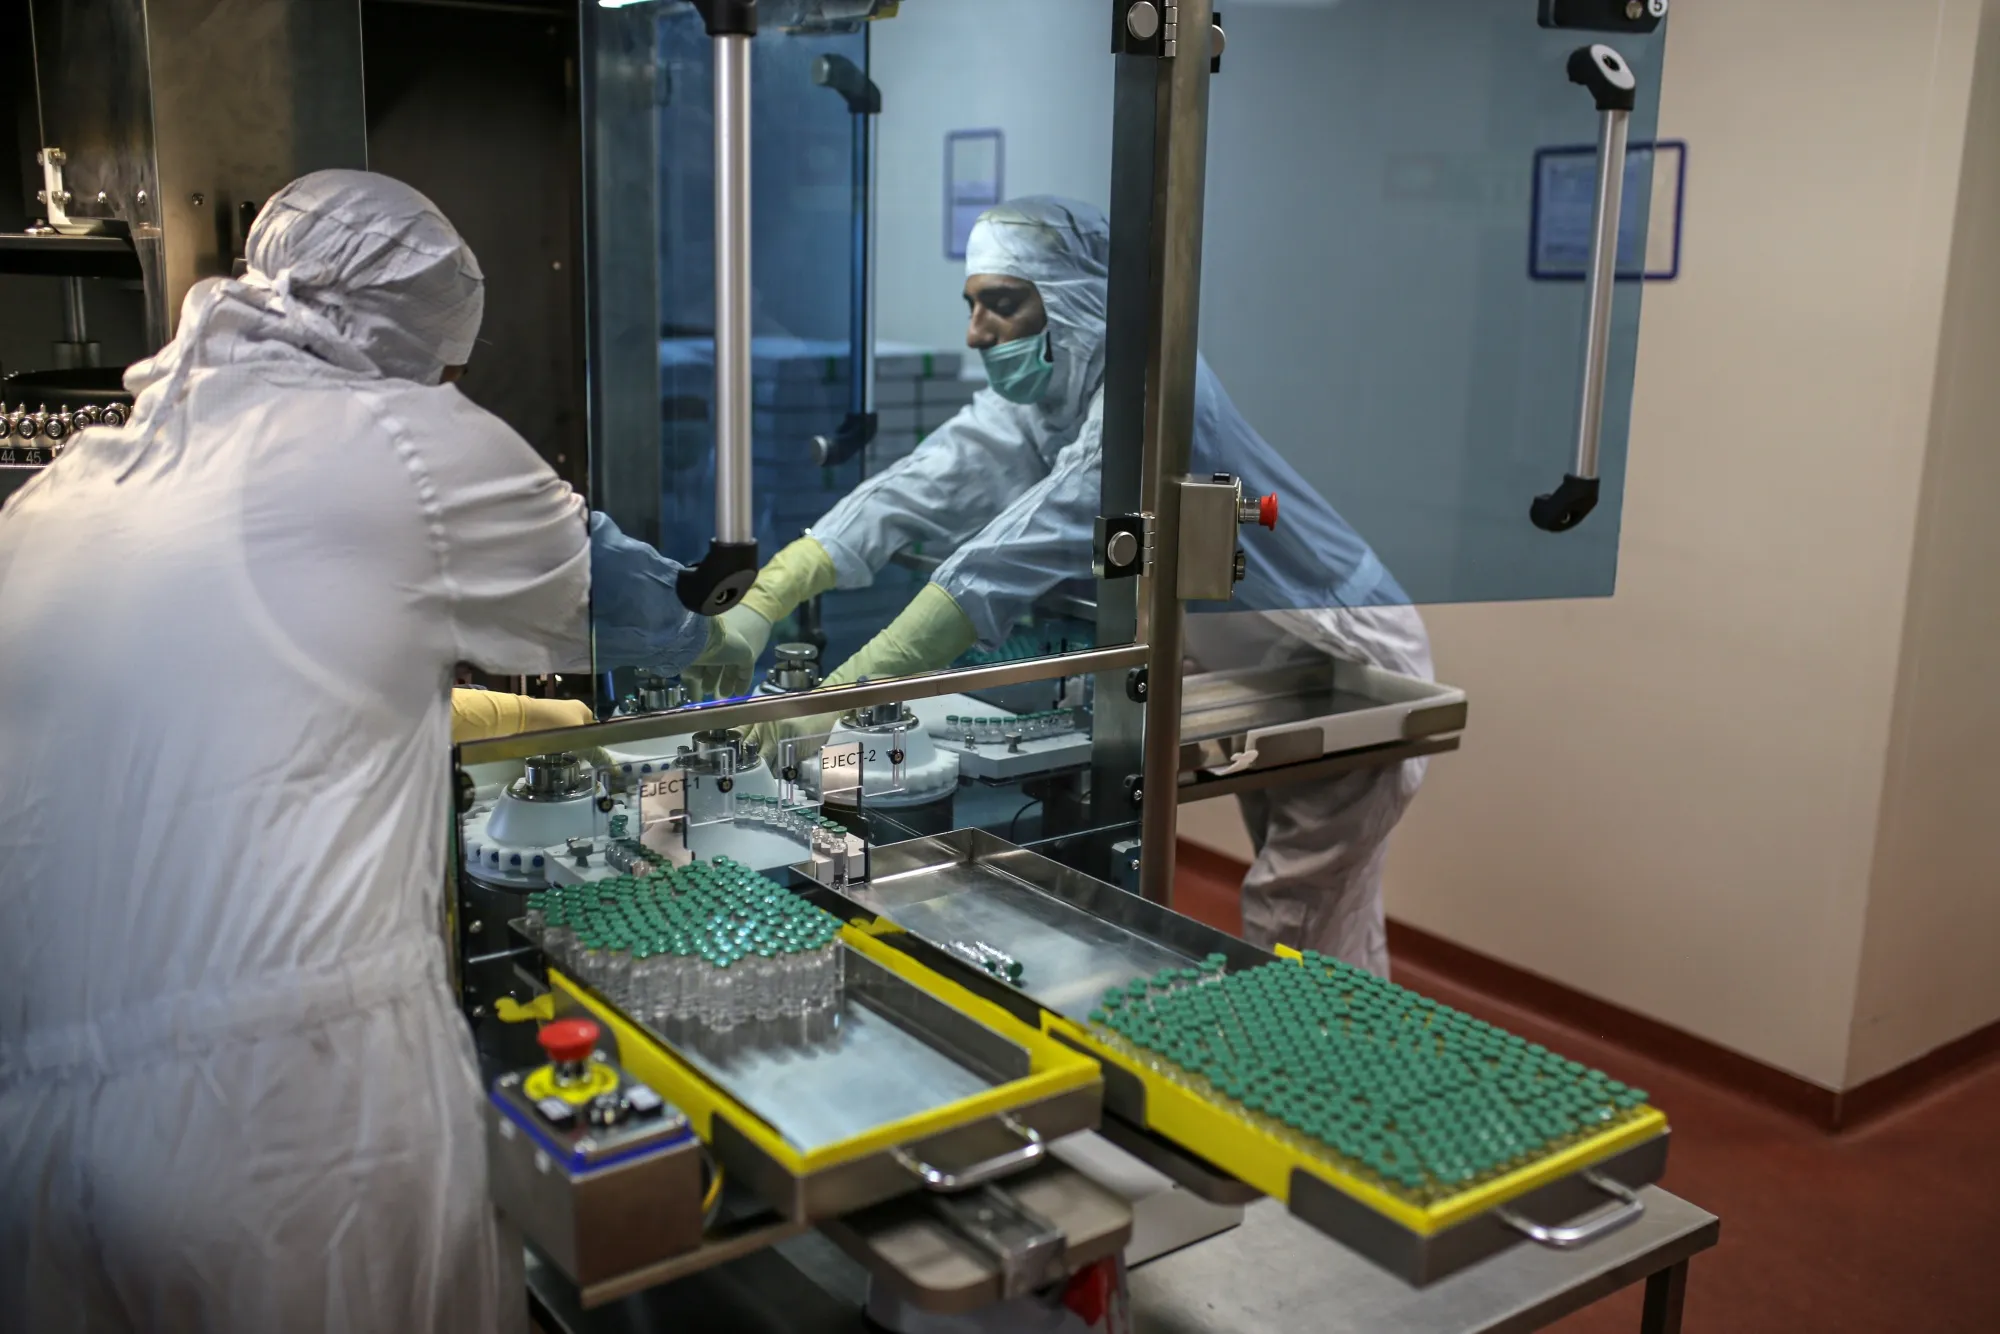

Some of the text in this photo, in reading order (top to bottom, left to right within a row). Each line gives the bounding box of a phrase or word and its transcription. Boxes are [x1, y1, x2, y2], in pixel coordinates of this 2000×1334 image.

[1, 450, 42, 466] 44 45
[822, 749, 877, 770] EJECT-2
[640, 776, 700, 798] EJECT-1
